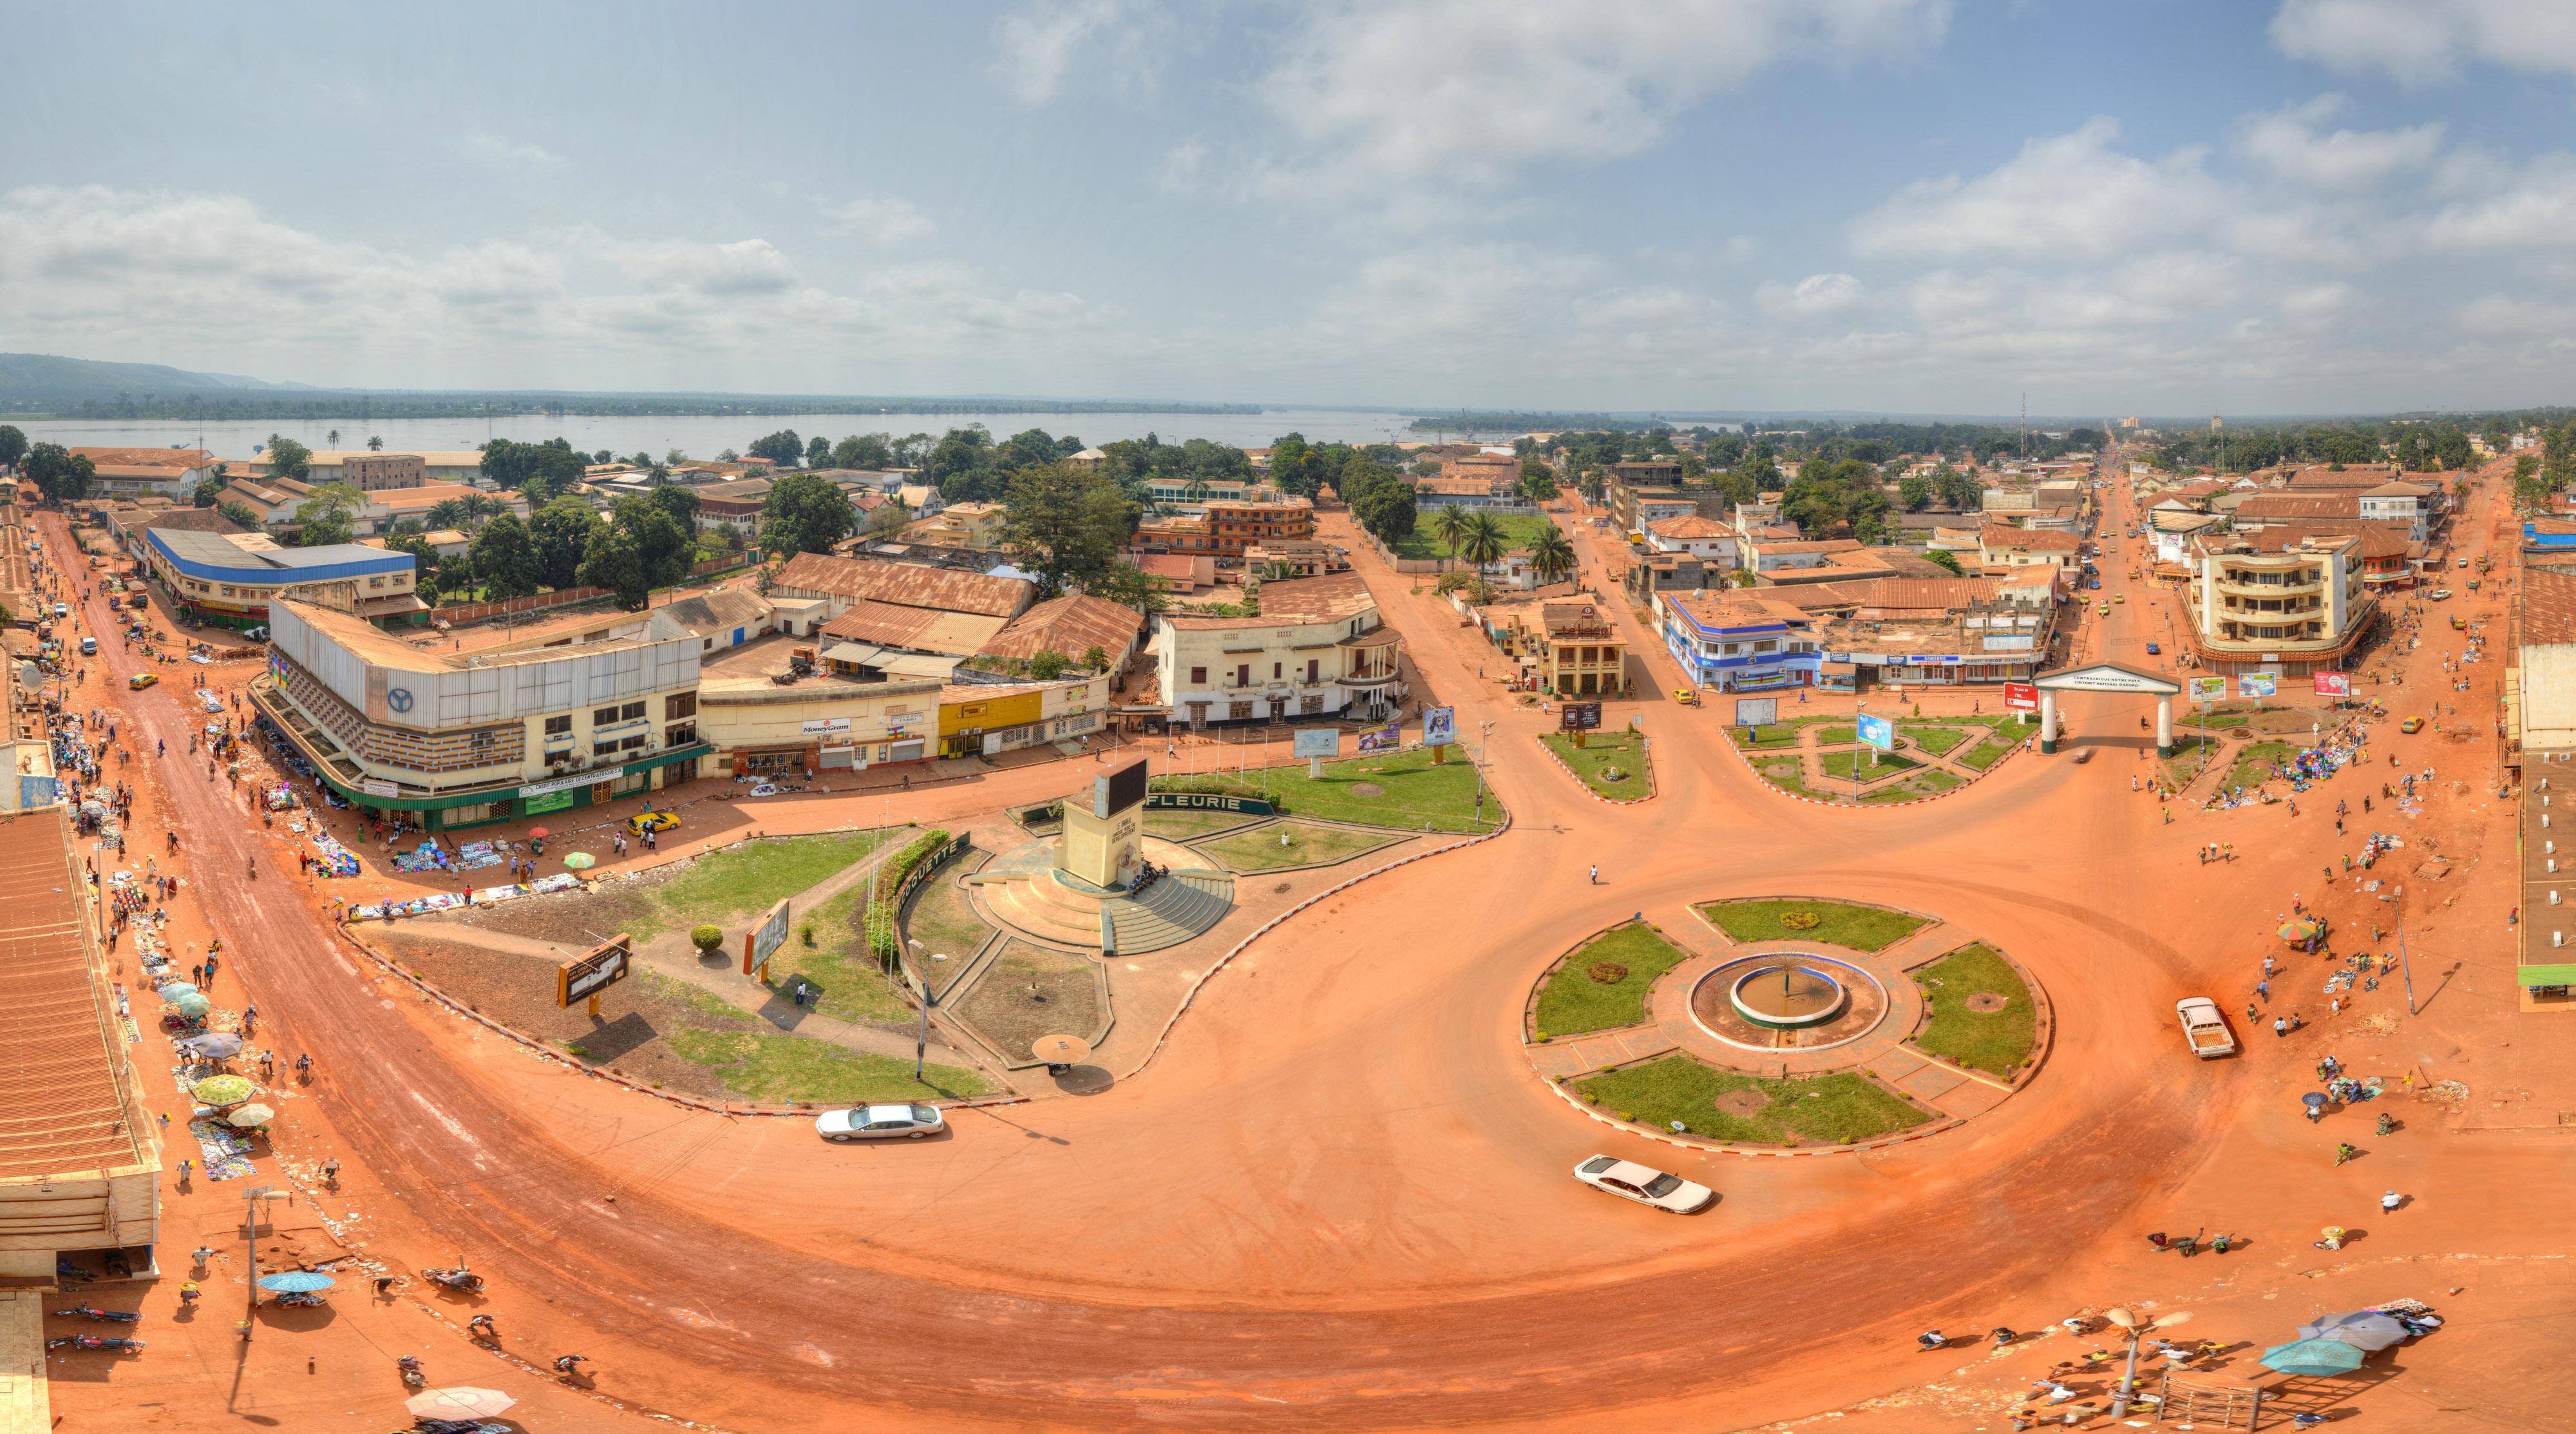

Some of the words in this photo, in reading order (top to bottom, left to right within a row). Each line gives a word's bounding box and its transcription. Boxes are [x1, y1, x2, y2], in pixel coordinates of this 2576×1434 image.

[1562, 623, 1613, 636] telecel
[551, 778, 574, 787] POPULAIRE
[1146, 795, 1240, 810] FLEURIE
[1116, 822, 1121, 830] LE
[1121, 816, 1132, 828] TRAVAIL
[1112, 829, 1123, 838] UNIQUE
[1112, 827, 1135, 844] DEVELOPPEMENT
[902, 839, 958, 904] COQUETTE
[577, 963, 592, 973] gagne
[594, 956, 605, 964] tous
[609, 948, 619, 957] être
[569, 968, 592, 981] identifiés
